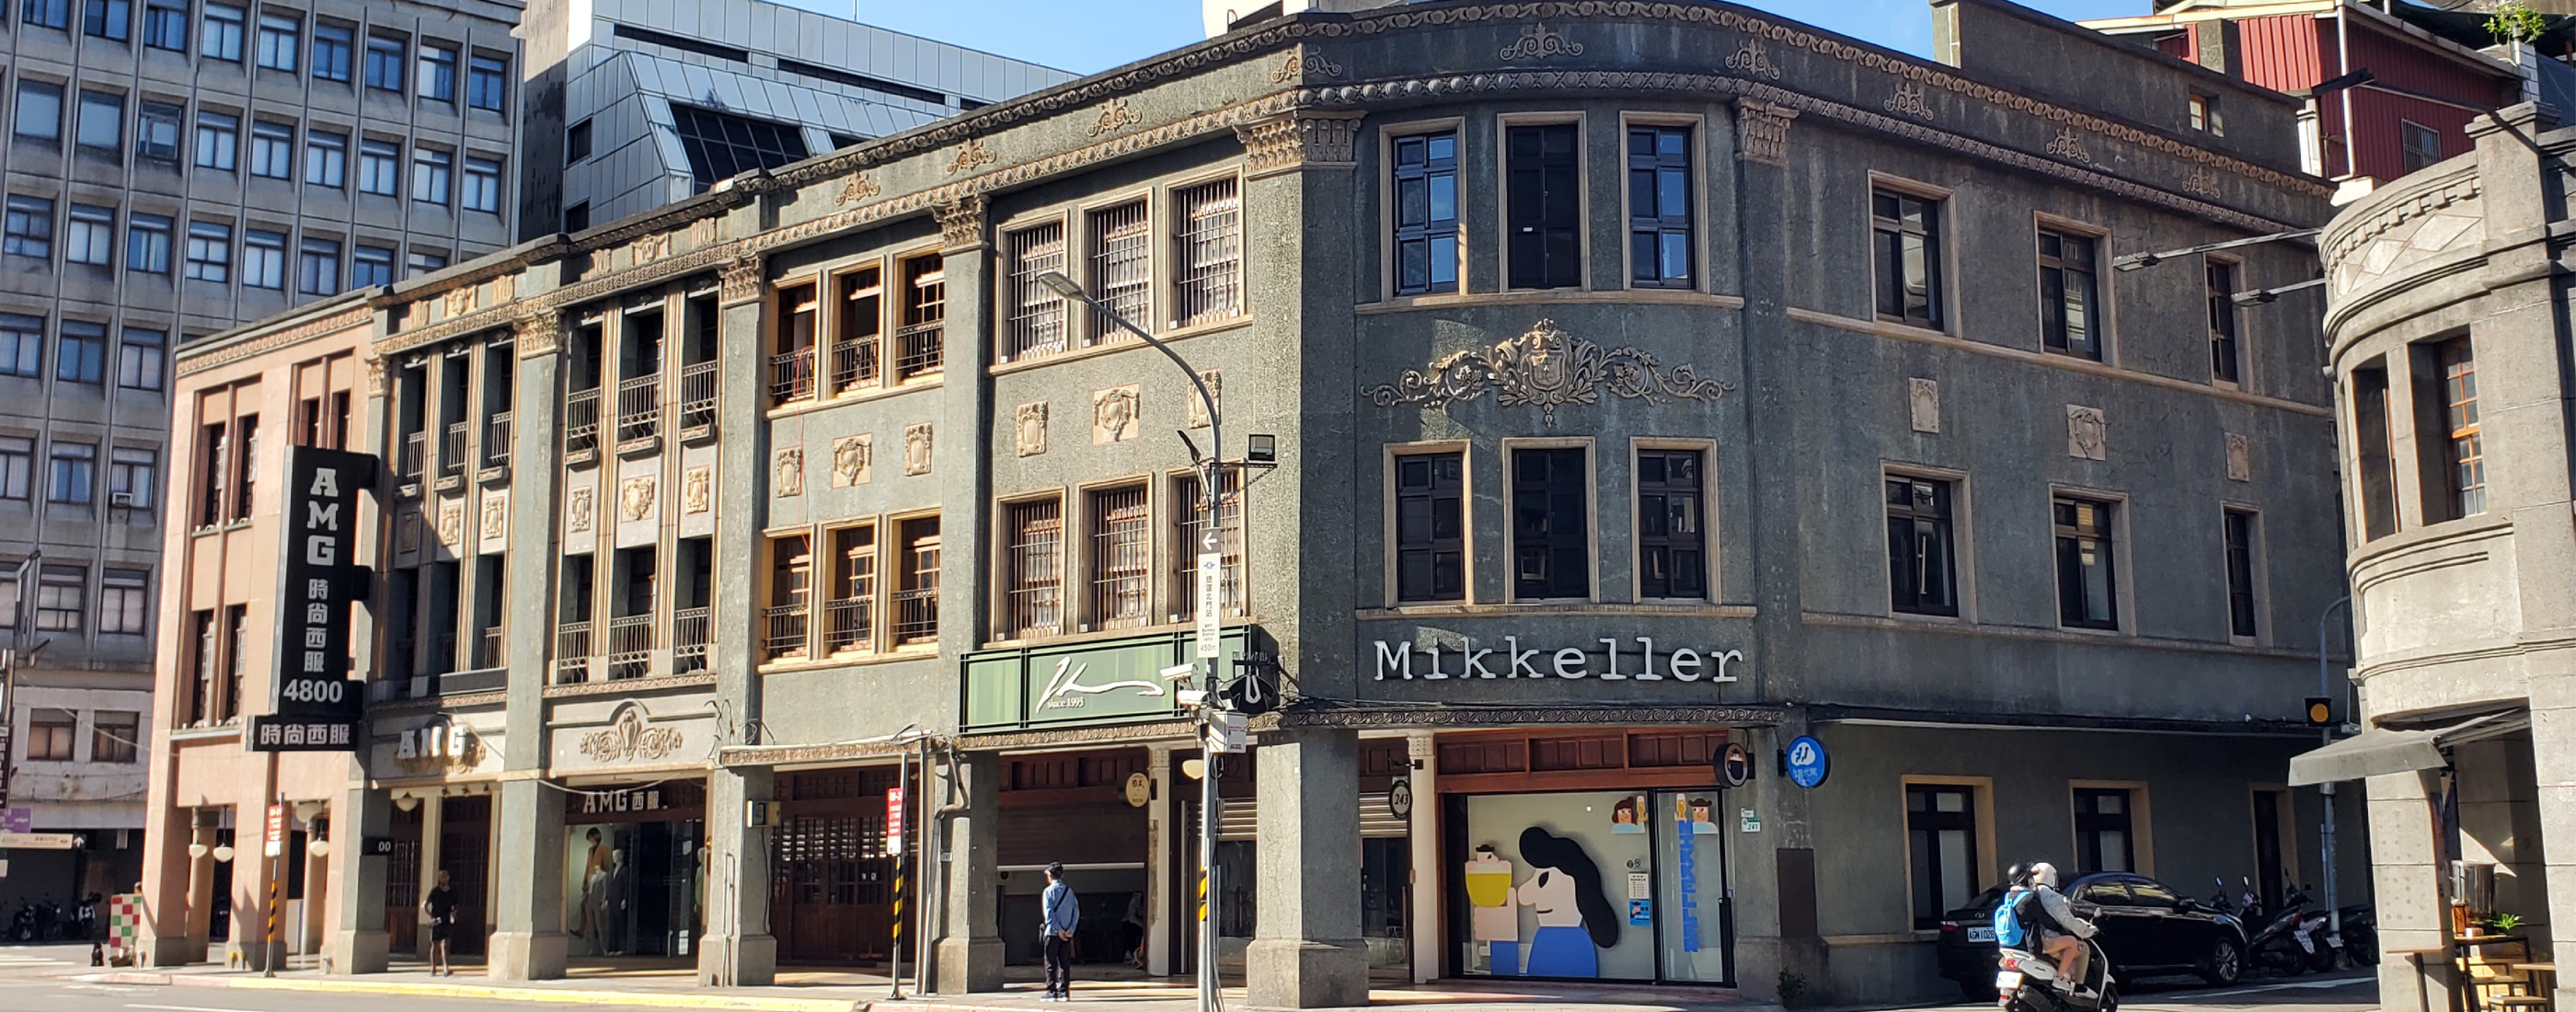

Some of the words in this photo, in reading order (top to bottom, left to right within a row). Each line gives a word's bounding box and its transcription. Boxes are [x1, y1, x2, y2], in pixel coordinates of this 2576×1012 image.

[307, 467, 339, 566] AMG
[304, 579, 328, 672] 時尚西服
[1374, 636, 1743, 683] Mikkeller
[283, 679, 343, 702] 4800
[1047, 699, 1066, 708] since
[260, 724, 350, 744] 時尚西服
[397, 726, 466, 759] AMG
[582, 790, 627, 813] AMG
[632, 791, 660, 811] 西服
[1395, 793, 1409, 805] 243
[1678, 819, 1699, 953] MIKKELLER
